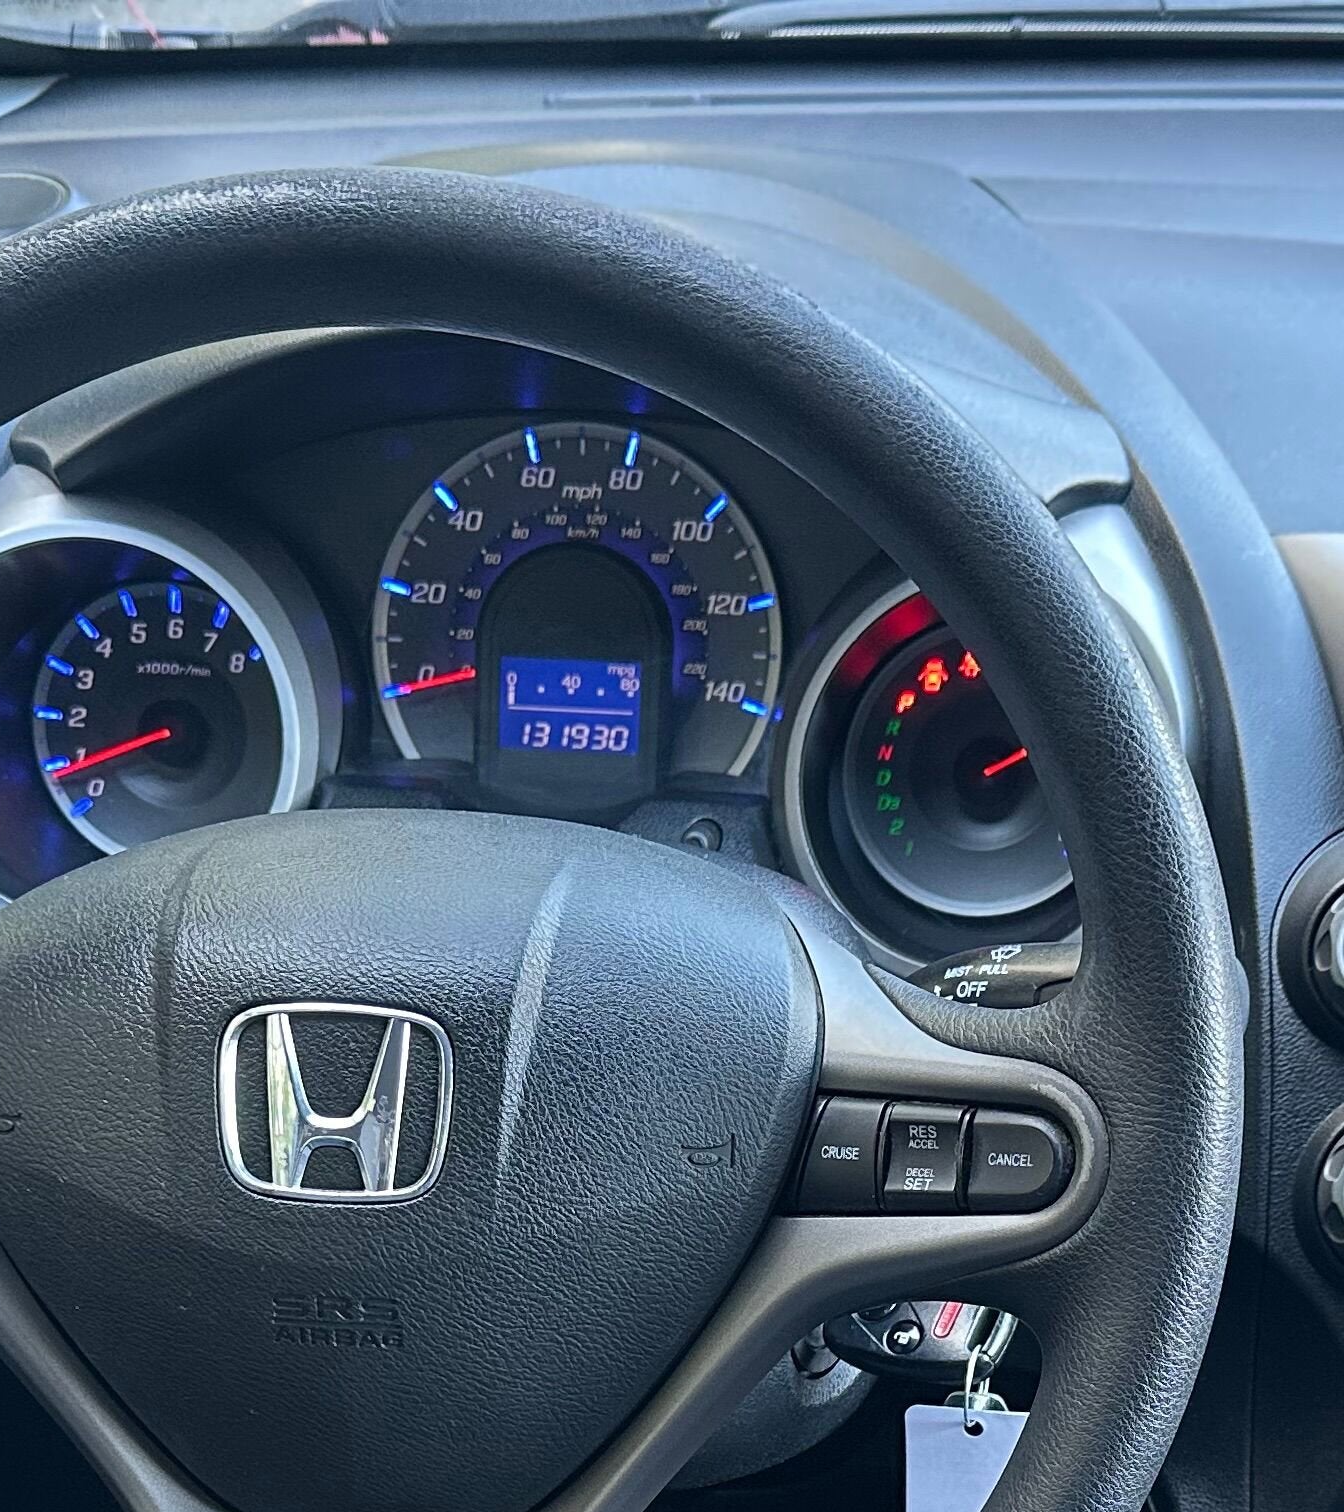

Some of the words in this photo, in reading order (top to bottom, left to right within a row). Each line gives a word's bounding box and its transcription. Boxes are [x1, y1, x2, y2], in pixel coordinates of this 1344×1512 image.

[520, 467, 555, 489] 60
[609, 469, 643, 491] 80
[562, 485, 602, 500] mph
[448, 510, 483, 531] 40
[545, 514, 567, 526] 100
[586, 514, 607, 526] 120
[511, 528, 529, 539] 80
[567, 527, 599, 538] km/h
[620, 527, 641, 538] 140
[672, 520, 713, 542] 100
[411, 583, 446, 605] 20
[464, 588, 481, 600] 40
[707, 595, 748, 616] 120
[130, 623, 148, 644] 5
[168, 619, 184, 639] 6
[683, 620, 707, 631] 200
[204, 633, 219, 653] 7
[456, 629, 474, 641] 20
[96, 637, 113, 658] 4
[136, 662, 211, 678] x1000r/min
[229, 653, 245, 673] 8
[608, 664, 636, 678] mpg
[683, 663, 707, 675] 220
[76, 670, 94, 690] 3
[561, 674, 581, 689] 40
[706, 681, 746, 704] 140
[68, 707, 87, 728] 2
[522, 721, 629, 751] 131930
[877, 745, 894, 760] N
[876, 769, 892, 787] D
[88, 779, 105, 797] 0
[888, 818, 904, 835] 2
[944, 964, 972, 979] MIST
[979, 963, 1008, 976] PULL
[957, 981, 988, 998] OFF
[908, 1125, 937, 1139] RES
[908, 1139, 939, 1150] ACCEL
[821, 1145, 859, 1161] CRUISE
[988, 1153, 1034, 1168] CANCEL
[906, 1167, 935, 1178] DECEL
[903, 1178, 933, 1191] SET
